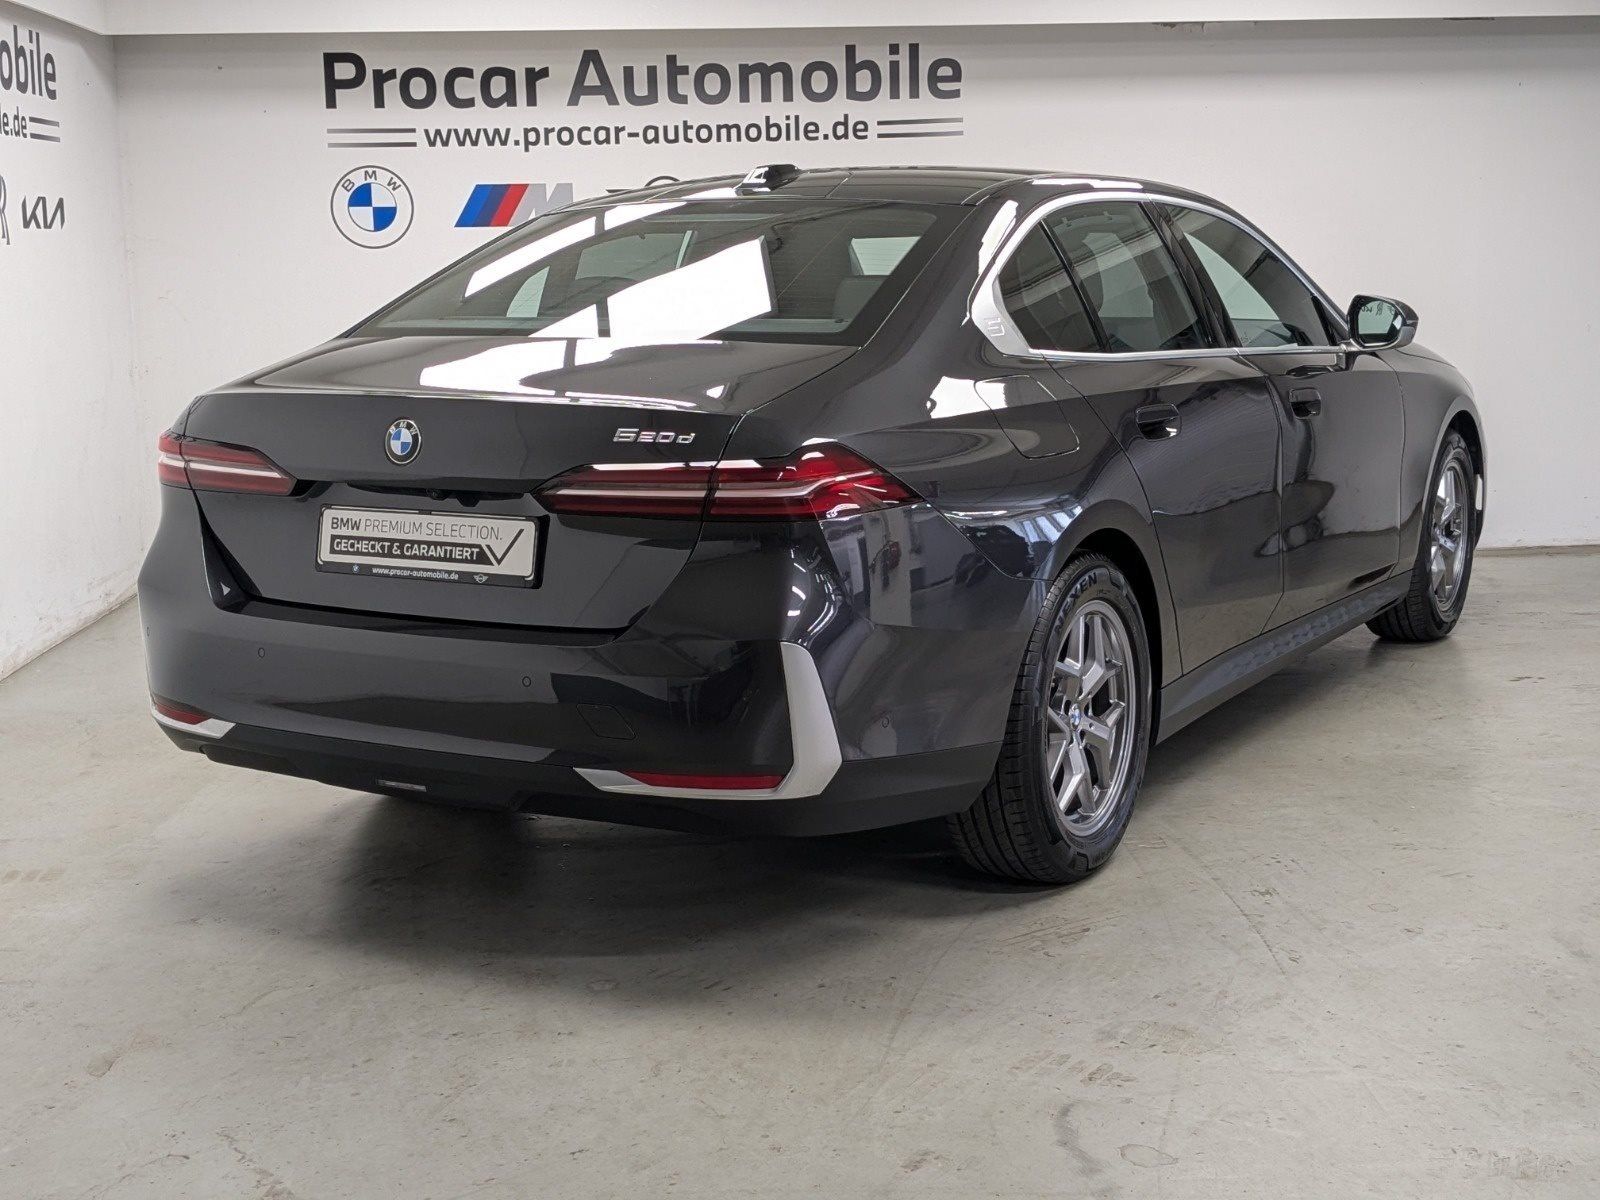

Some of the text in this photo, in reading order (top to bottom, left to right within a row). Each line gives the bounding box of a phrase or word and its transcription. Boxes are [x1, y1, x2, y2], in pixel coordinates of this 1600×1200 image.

[0, 24, 57, 101] obile
[323, 43, 963, 110] Procar Automobile
[424, 114, 870, 151] www.procar-automobile.de
[341, 169, 402, 193] BMW
[612, 428, 697, 444] 520d
[331, 516, 362, 532] BMW
[364, 518, 423, 537] PREMIUM
[333, 538, 480, 560] GECHECKT & GARANTIERT
[372, 566, 459, 581] www.procar-automobile.de
[1053, 571, 1098, 637] NEXEN
